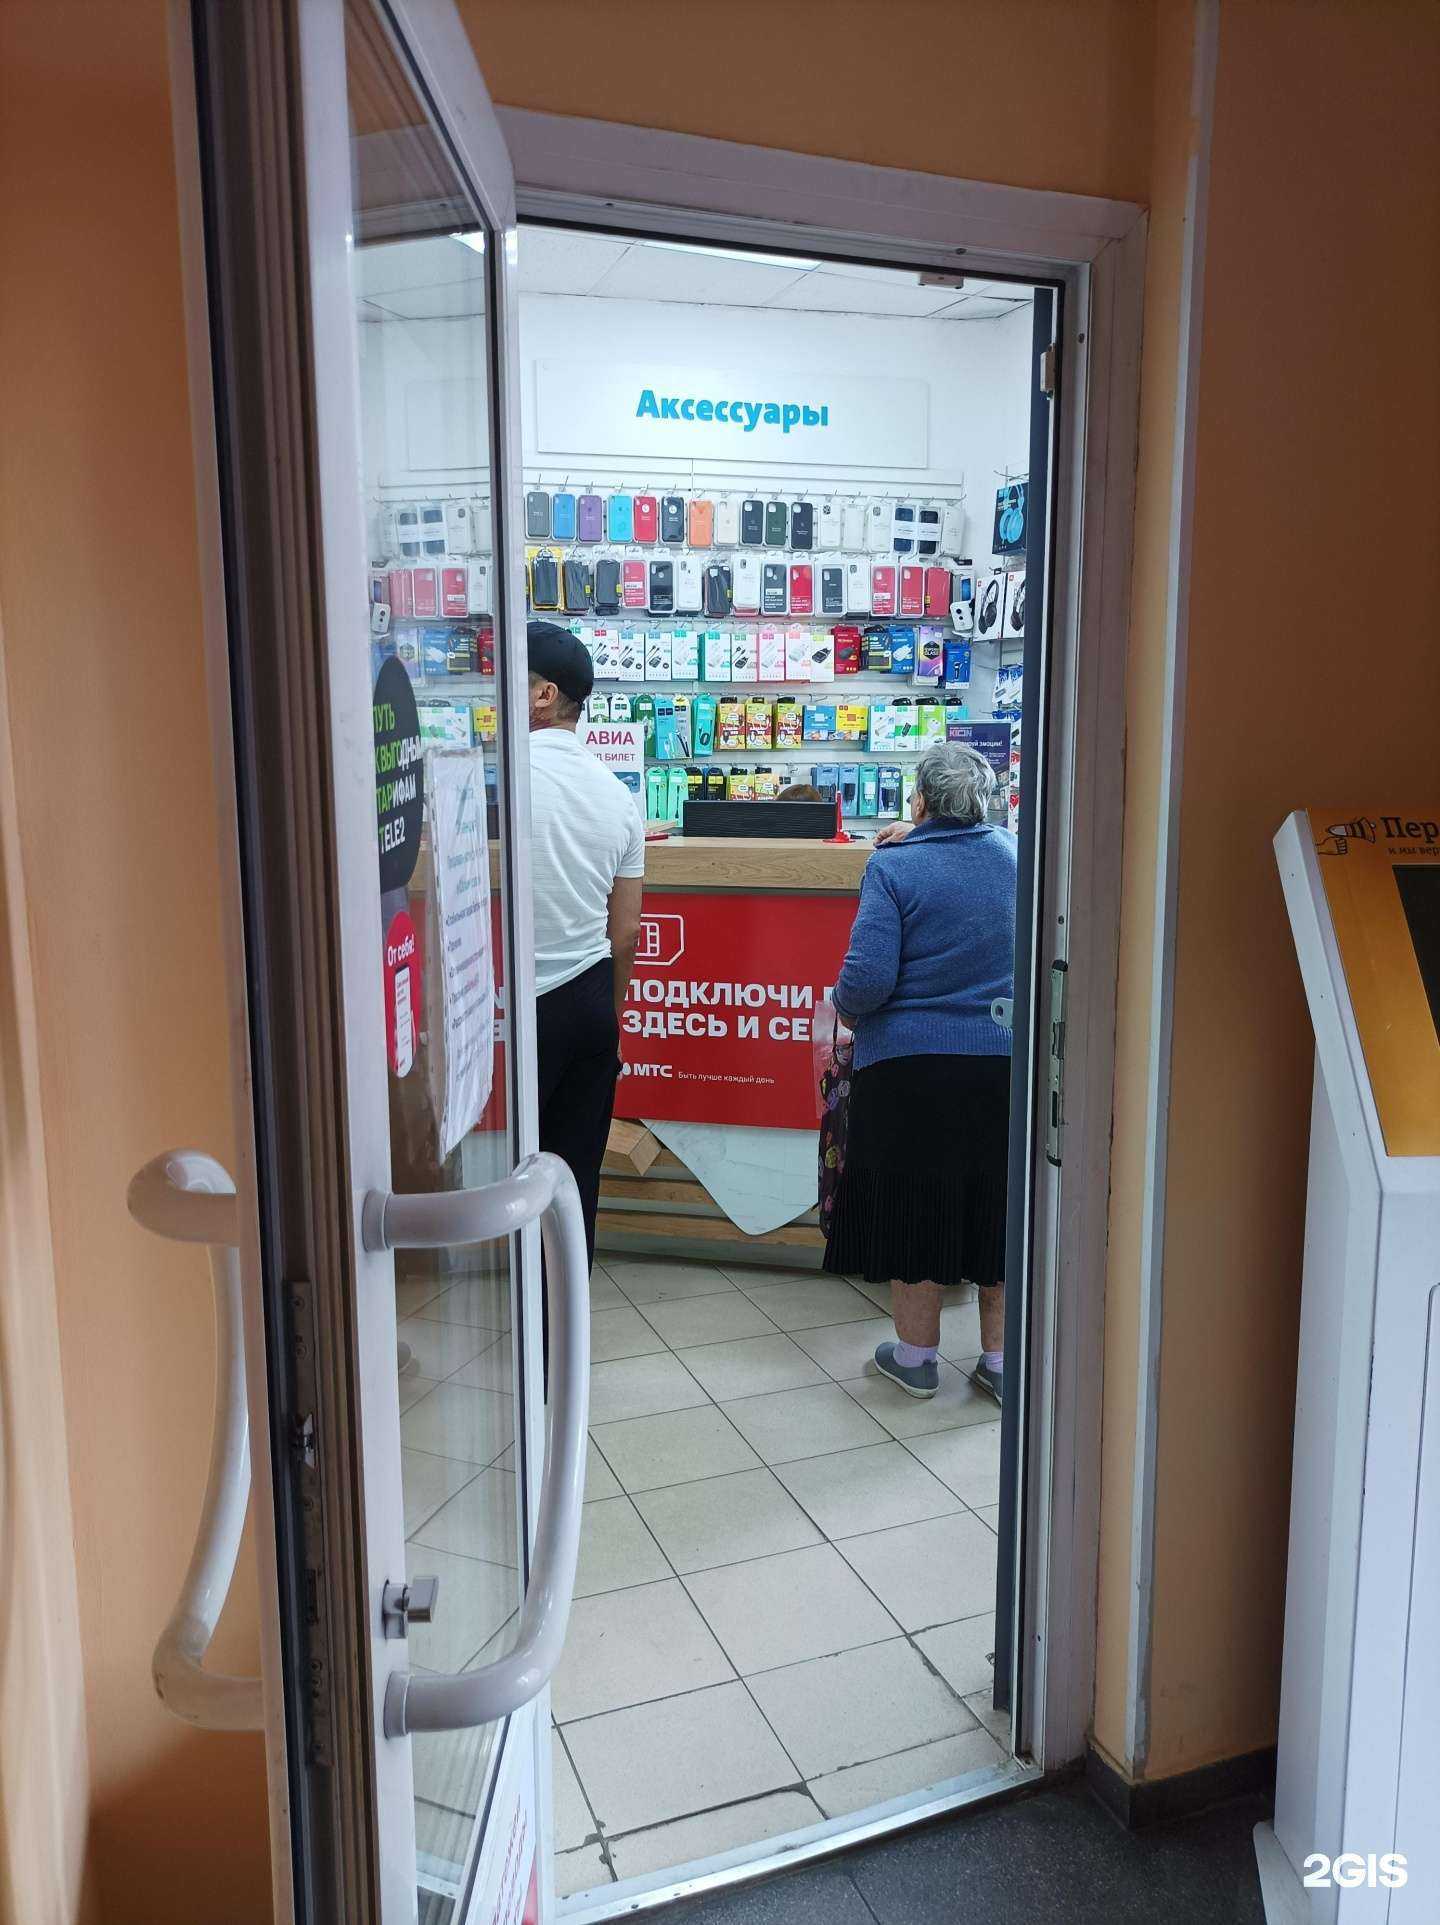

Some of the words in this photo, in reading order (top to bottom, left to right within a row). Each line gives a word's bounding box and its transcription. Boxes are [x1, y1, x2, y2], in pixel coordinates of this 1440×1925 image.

[636, 389, 829, 433] Аксессуары
[586, 730, 635, 745] АВИА
[604, 752, 636, 762] БИЛЕТ
[376, 774, 416, 814] ТАРИФАМ
[379, 816, 405, 855] TELE2
[388, 945, 397, 967] От
[398, 933, 415, 961] себя!
[624, 979, 812, 1009] ПОДКЛЮЧИ
[622, 1009, 728, 1038] ЗДЕСЬ
[737, 1015, 760, 1039] И
[768, 1016, 815, 1041] СЕ
[633, 1063, 673, 1078] МТС
[678, 1071, 698, 1080] Быть
[698, 1073, 723, 1082] лучше
[724, 1075, 755, 1083] каждый
